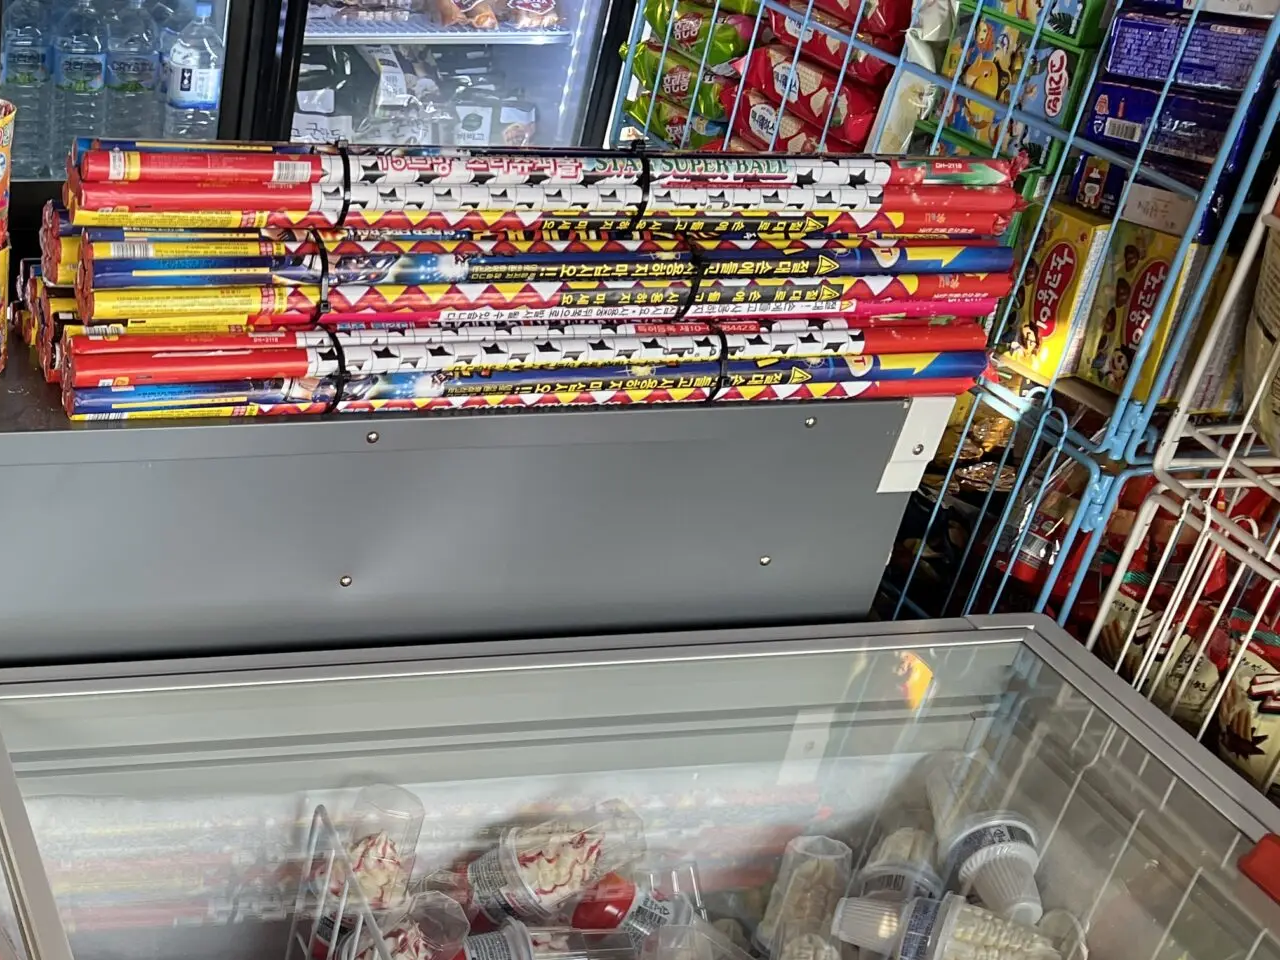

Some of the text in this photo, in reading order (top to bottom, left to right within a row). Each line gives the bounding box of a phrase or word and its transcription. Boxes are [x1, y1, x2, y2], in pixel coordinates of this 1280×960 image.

[662, 158, 730, 173] SUPER
[736, 158, 789, 173] BALL
[1036, 247, 1075, 331] 초코송이
